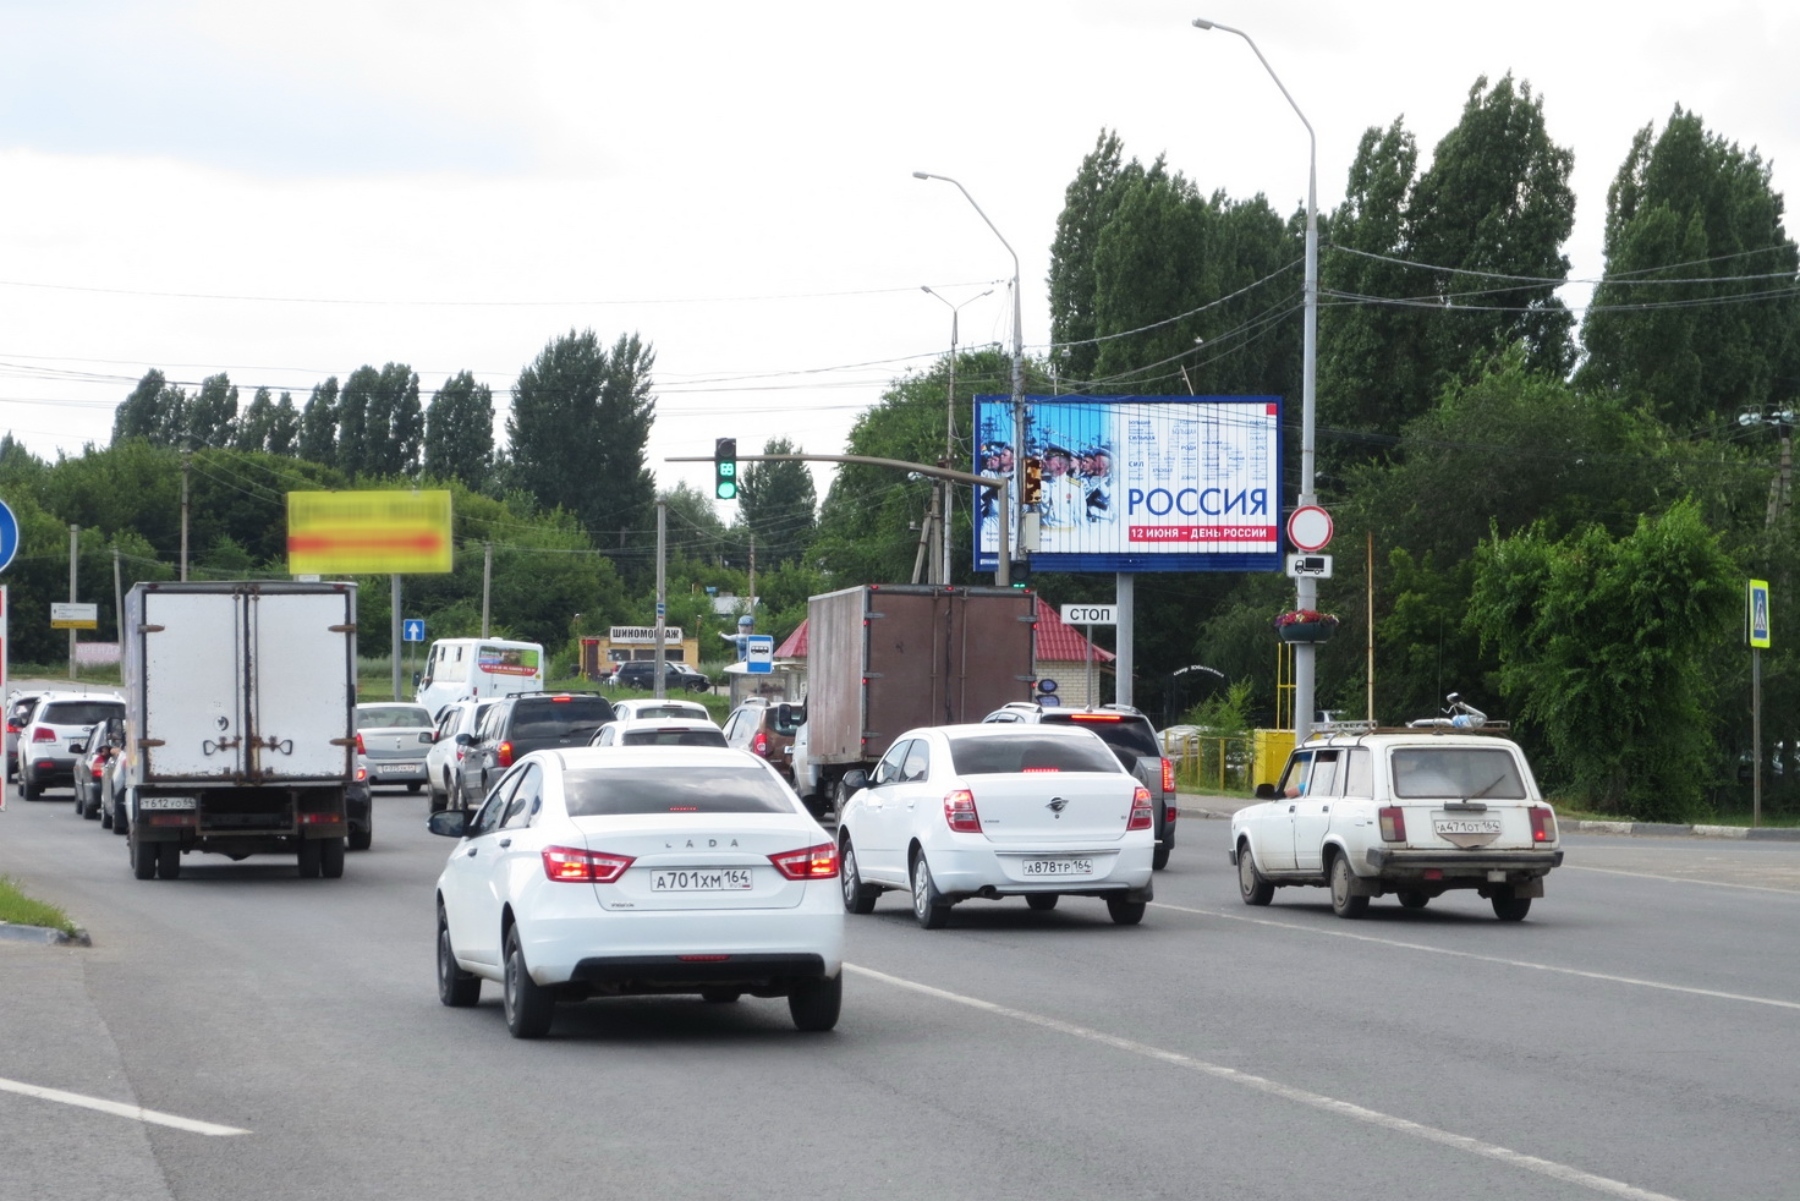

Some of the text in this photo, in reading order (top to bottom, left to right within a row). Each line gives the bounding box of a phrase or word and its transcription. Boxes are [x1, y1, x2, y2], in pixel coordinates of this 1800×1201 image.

[1129, 488, 1267, 516] РОССИЯ
[1131, 528, 1144, 538] 12
[1146, 528, 1179, 538] ИЮНЯ
[1190, 528, 1221, 539] ДЕНЬ
[1224, 528, 1267, 538] РОССИИ
[1070, 608, 1110, 621] СТОП
[612, 628, 680, 639] ШИНОМОАЖ
[665, 839, 739, 848] LADA
[1027, 860, 1091, 873] А878ТР 164
[657, 871, 749, 889] А701ХМ 164
